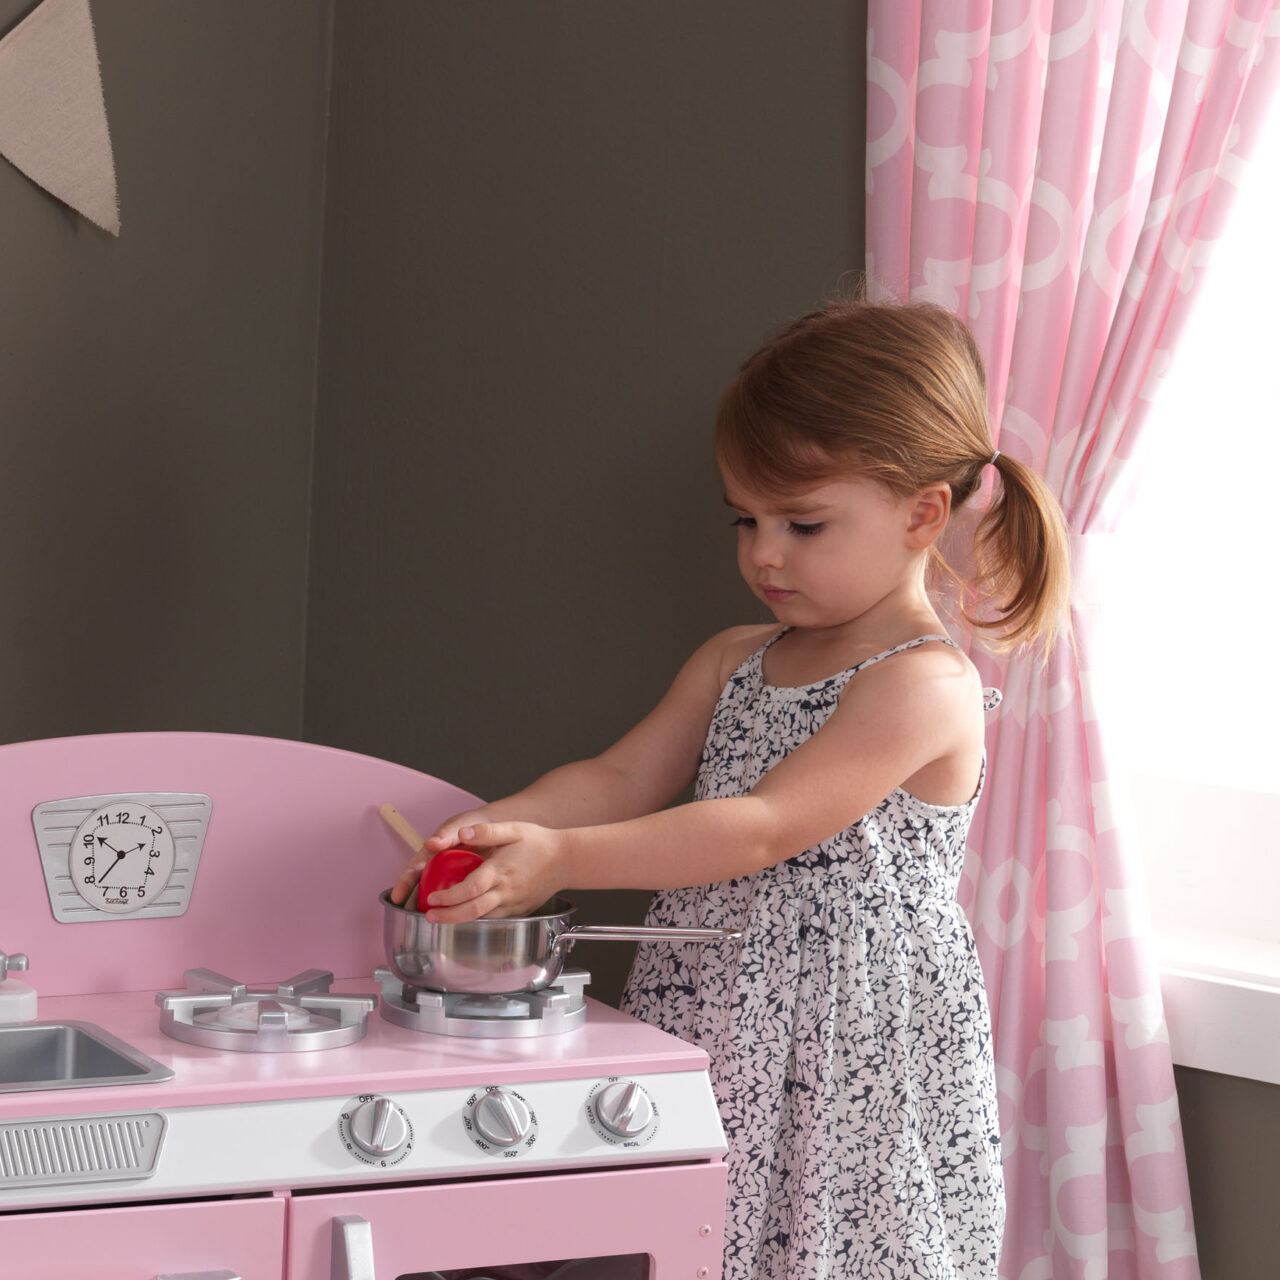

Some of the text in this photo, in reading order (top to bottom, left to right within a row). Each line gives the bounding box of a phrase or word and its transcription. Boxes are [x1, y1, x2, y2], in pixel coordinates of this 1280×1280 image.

[96, 814, 110, 826] 11
[116, 812, 130, 824] 12
[139, 815, 146, 826] 1
[151, 826, 162, 836] 2
[83, 834, 94, 848] 10
[149, 849, 160, 858] 3
[84, 857, 95, 865] 9
[144, 867, 155, 876] 4
[85, 875, 95, 884] 8
[102, 887, 109, 896] 7
[119, 886, 127, 898] 6
[137, 886, 145, 897] 5
[359, 1095, 375, 1103] OFF
[587, 1105, 596, 1124] CLEAN
[475, 1139, 490, 1150] 400°
[503, 1150, 518, 1158] 350°
